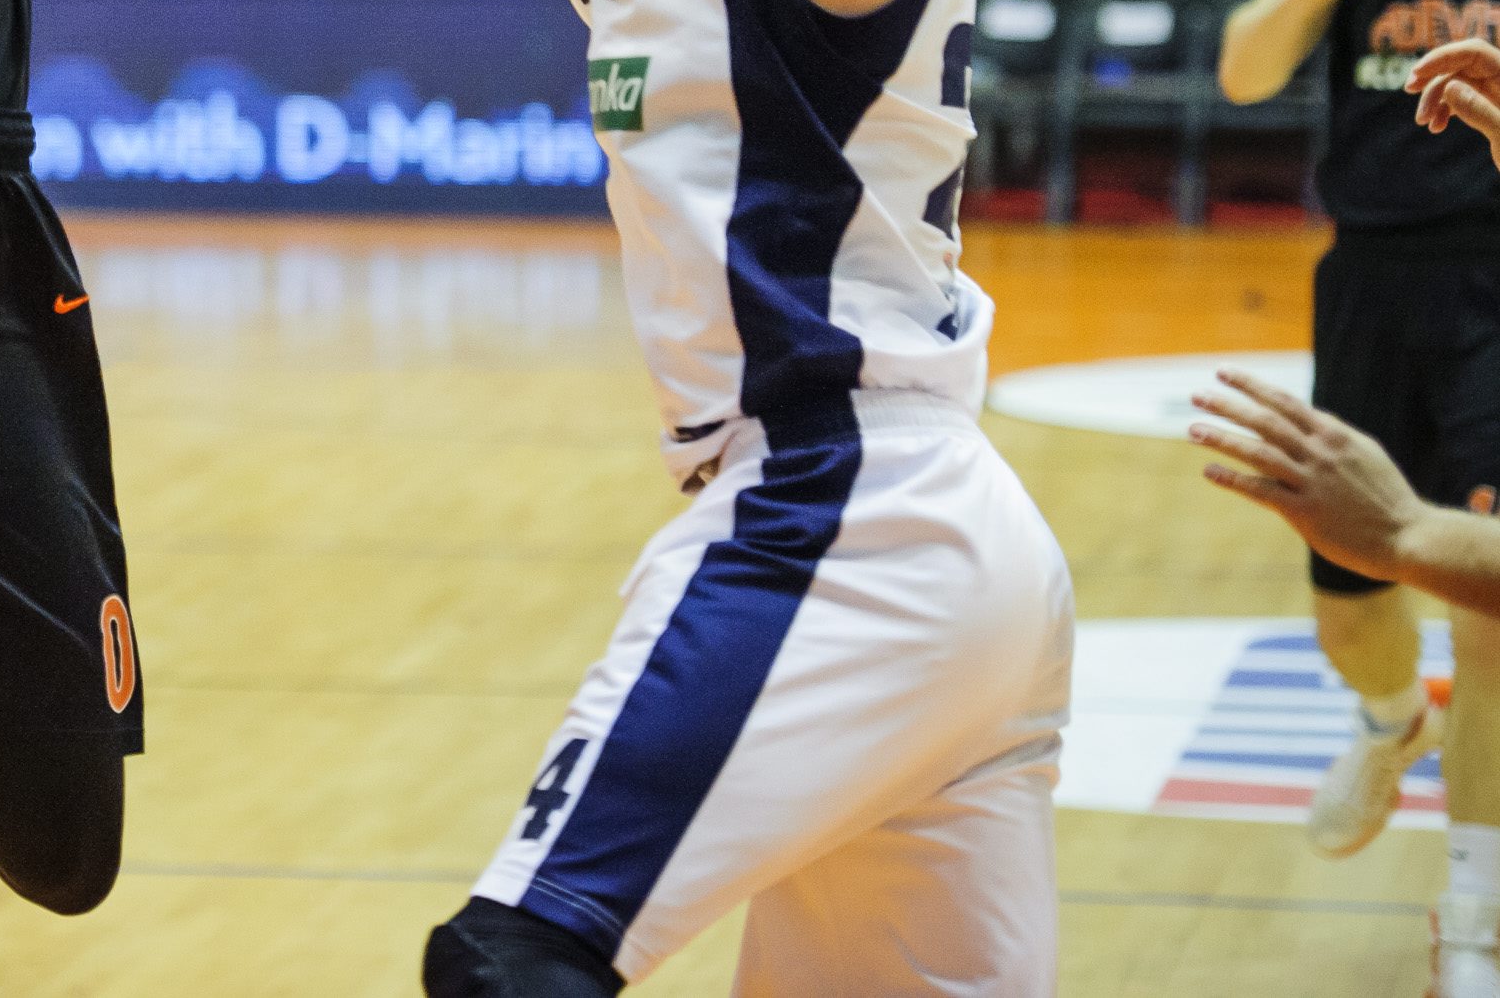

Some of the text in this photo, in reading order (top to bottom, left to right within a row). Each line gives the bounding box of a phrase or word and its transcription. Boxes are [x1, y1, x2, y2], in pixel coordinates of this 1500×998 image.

[91, 92, 265, 184] with
[100, 594, 135, 714] 0
[520, 738, 589, 840] 4
